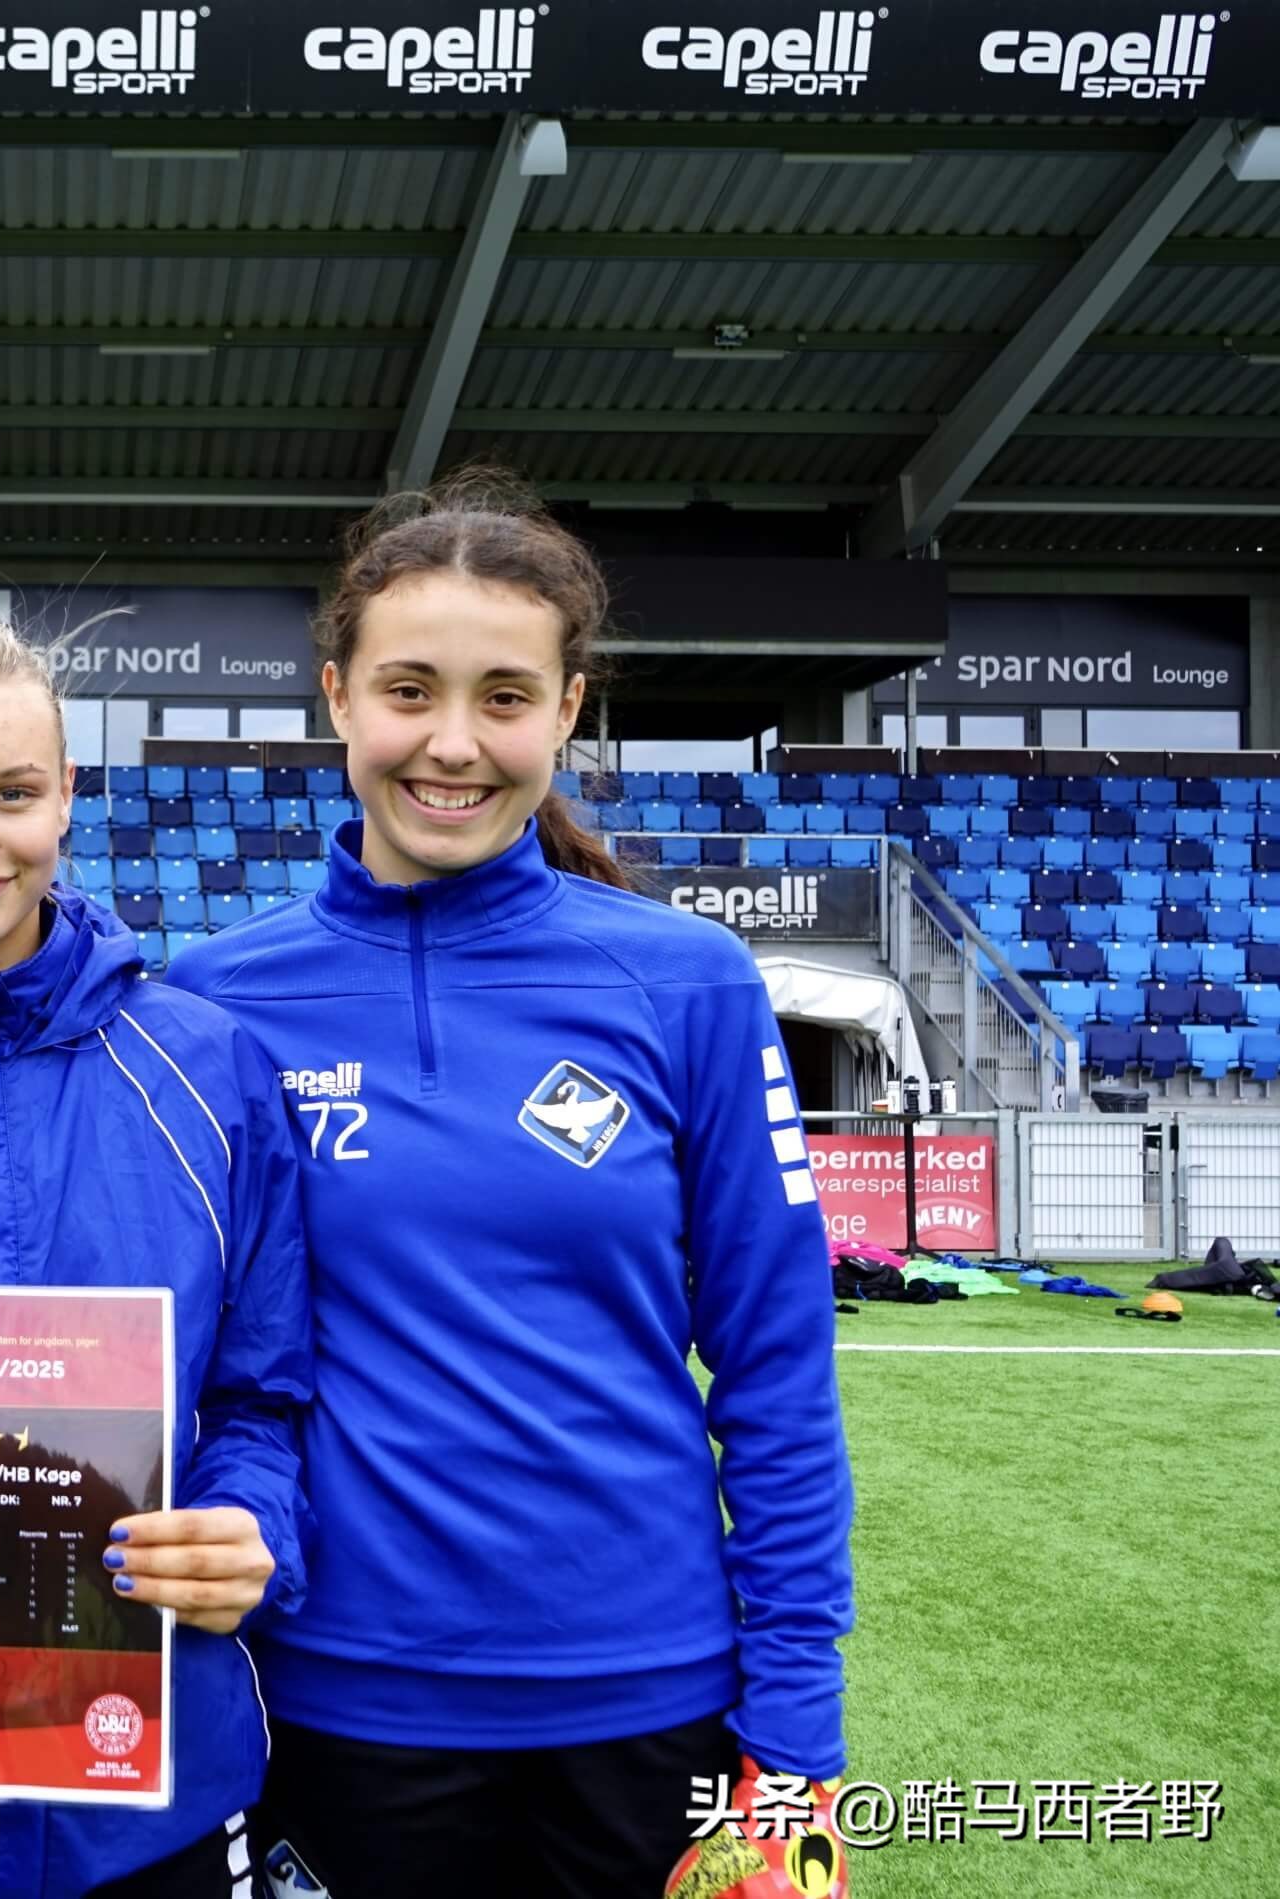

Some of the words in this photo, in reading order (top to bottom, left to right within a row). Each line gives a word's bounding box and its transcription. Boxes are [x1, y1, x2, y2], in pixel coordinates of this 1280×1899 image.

[303, 6, 536, 89] capelli
[641, 9, 875, 89] capelli
[979, 13, 1216, 93] capelli
[73, 71, 196, 95] SPORT
[408, 71, 532, 95] SPORT
[744, 72, 869, 96] SPORT
[1081, 75, 1207, 100] SPORT
[116, 641, 201, 674] Nord
[221, 655, 297, 680] Lounge
[1047, 651, 1132, 683] Nord
[1153, 665, 1229, 688] Lounge
[671, 875, 818, 924] capelli
[739, 913, 818, 928] SPORT
[278, 1062, 363, 1096] apelli
[306, 1086, 362, 1097] SPORT
[298, 1101, 369, 1161] 72
[915, 1205, 981, 1232] MENY
[19, 1335, 33, 1346] for
[35, 1467, 82, 1487] Køge
[0, 1495, 20, 1506] DK:
[51, 1496, 72, 1507] NR.
[73, 1496, 82, 1507] 7
[97, 1713, 130, 1734] DBU
